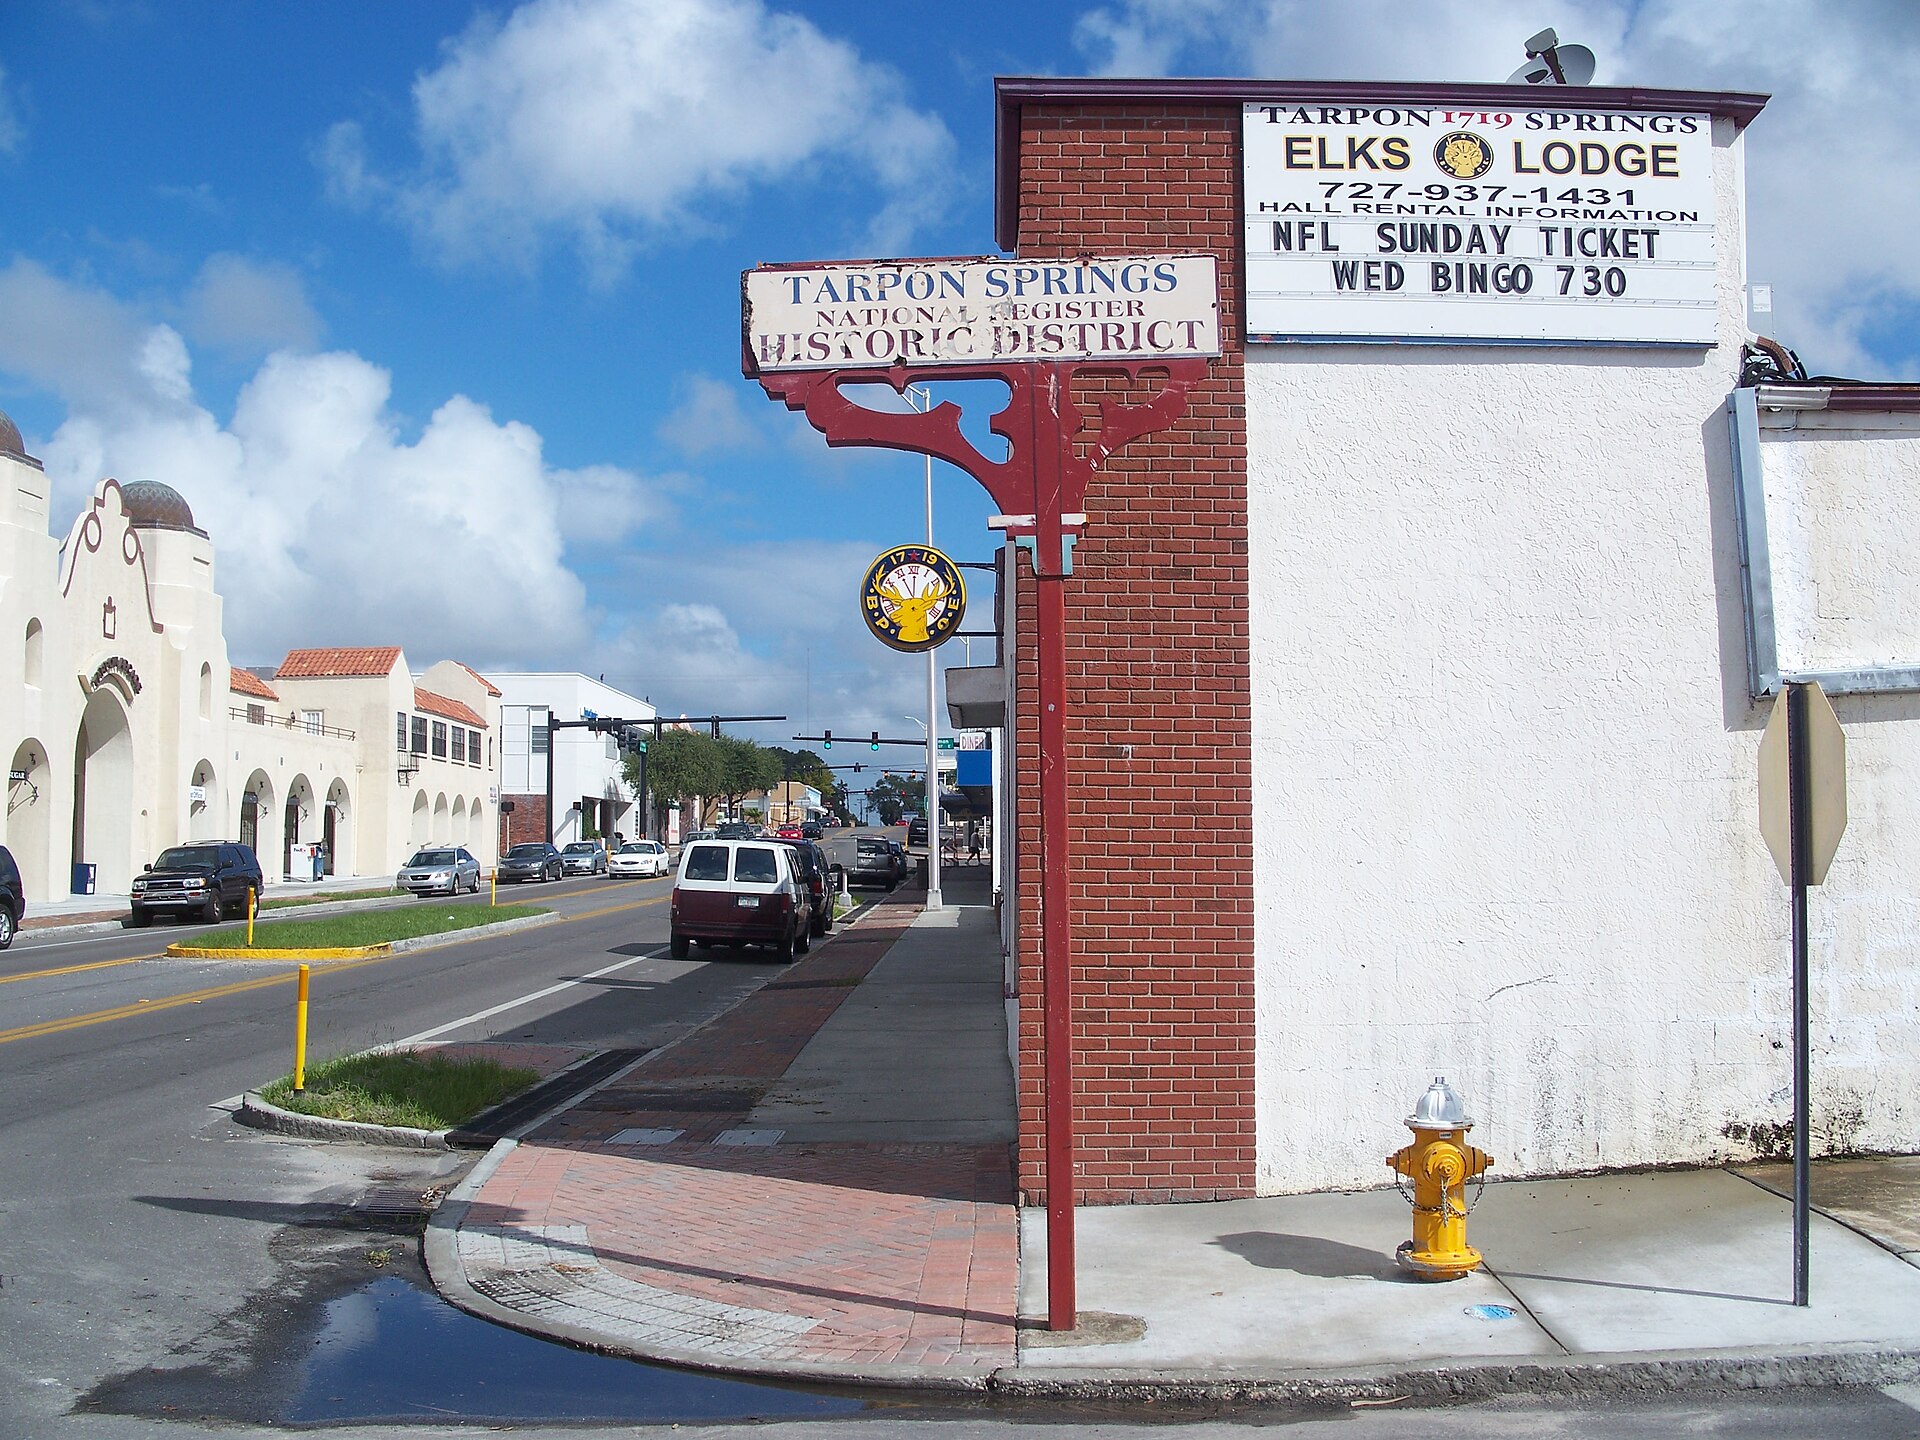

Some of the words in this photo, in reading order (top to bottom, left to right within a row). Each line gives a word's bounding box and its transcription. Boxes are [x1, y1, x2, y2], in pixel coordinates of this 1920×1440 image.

[1259, 106, 1433, 127] TARPON
[1442, 111, 1513, 130] 1719
[1525, 112, 1698, 134] SPRINGS
[1284, 135, 1412, 171] ELKS
[1512, 140, 1680, 178] LODGE
[1259, 201, 1342, 213] HALL
[1353, 203, 1476, 216] RENTAL
[1486, 206, 1698, 222] INFORMATION
[1318, 182, 1635, 206] 727-937-1431
[1272, 221, 1339, 251] NFL
[1376, 222, 1512, 255] SUNDAY
[1539, 226, 1660, 259] TICKET
[783, 269, 967, 304] TARPON
[985, 262, 1178, 299] SPRINGS
[1332, 260, 1405, 291] WED
[1431, 261, 1533, 294] BINGO
[1556, 265, 1627, 297] 730
[816, 305, 978, 328] NATIONAL
[759, 326, 974, 363] HISTORIC
[993, 319, 1205, 353] DISTRICT
